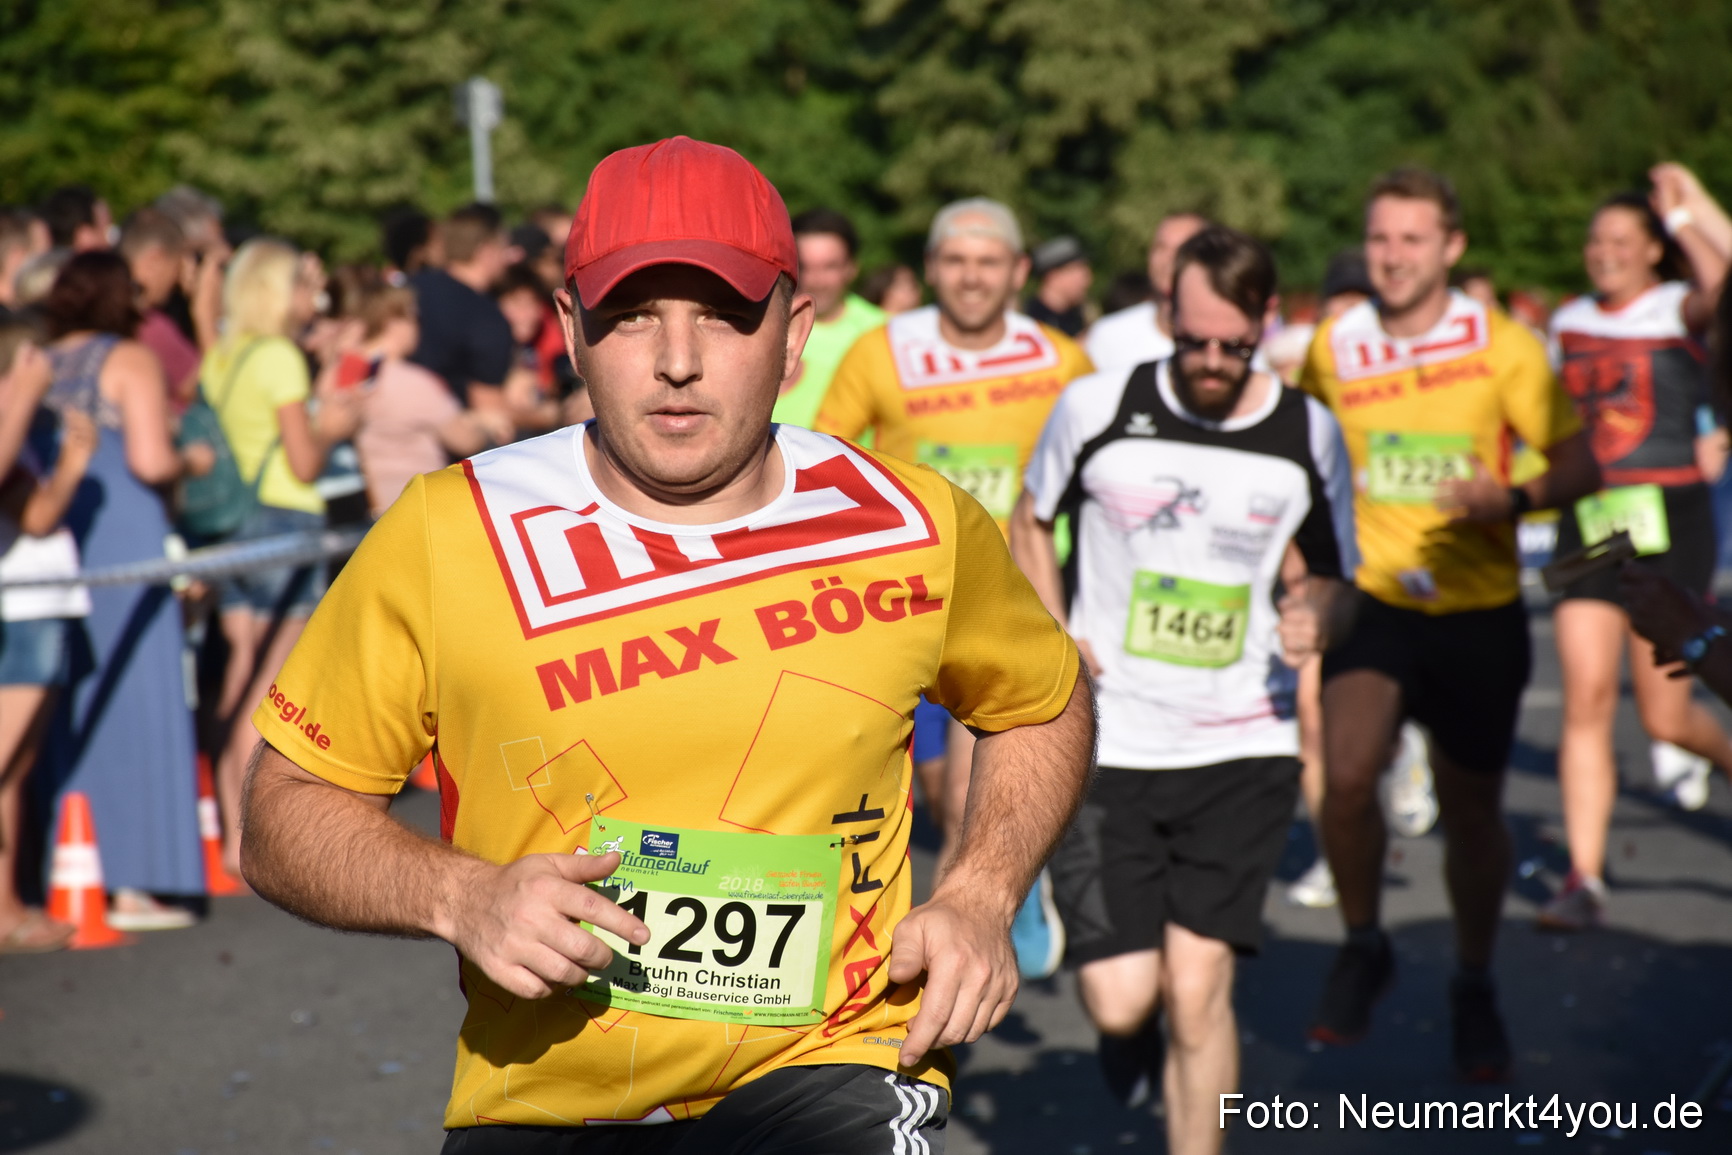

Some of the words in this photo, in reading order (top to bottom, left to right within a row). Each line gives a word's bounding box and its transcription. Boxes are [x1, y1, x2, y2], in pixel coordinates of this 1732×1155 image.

[1147, 605, 1235, 644] 1464
[535, 618, 738, 712] MAX
[754, 574, 944, 652] BÖGL
[268, 683, 331, 751] oegl.de
[620, 850, 711, 875] firmenlauf
[620, 866, 659, 876] neumarkt
[718, 875, 764, 893] 2018
[615, 890, 806, 969] 1297
[628, 960, 688, 983] Bruhn
[695, 969, 781, 990] Christian
[612, 976, 639, 992] Max
[643, 981, 673, 999] Bögl
[676, 986, 749, 1004] Bauservice
[753, 993, 792, 1005] GmbH
[713, 1008, 744, 1017] Frischmann
